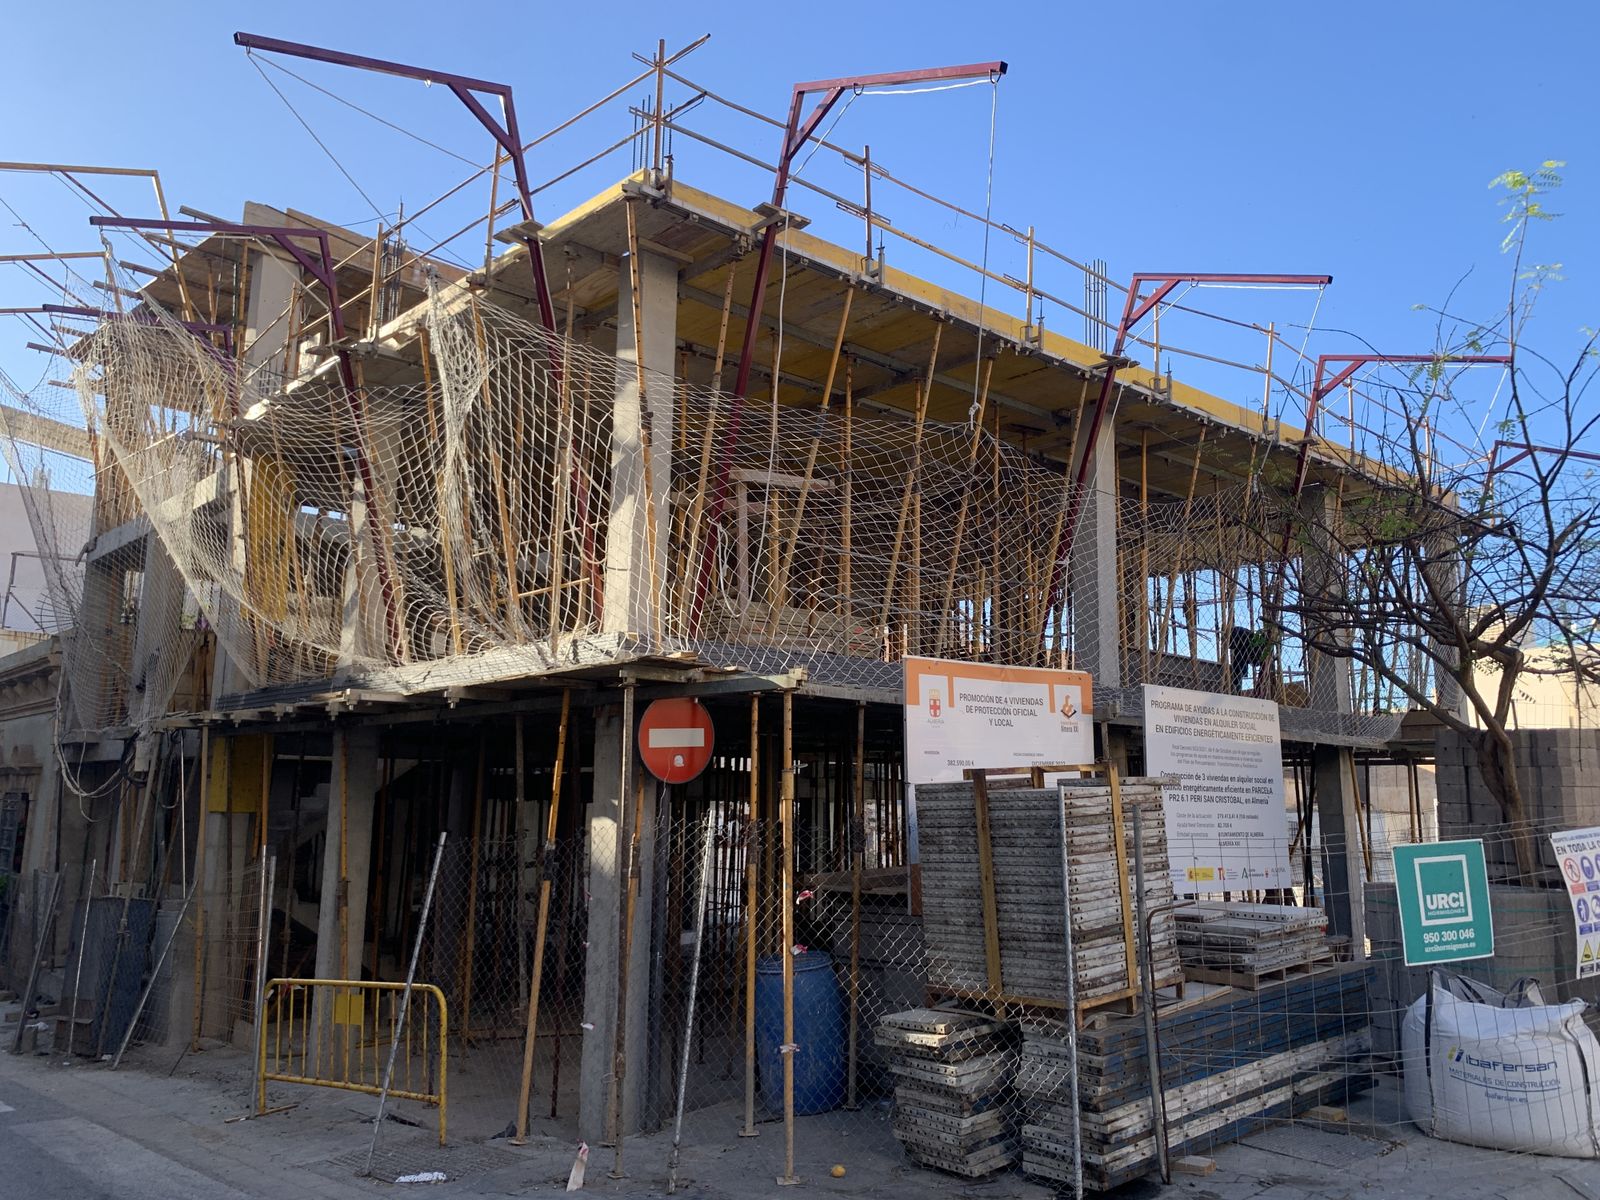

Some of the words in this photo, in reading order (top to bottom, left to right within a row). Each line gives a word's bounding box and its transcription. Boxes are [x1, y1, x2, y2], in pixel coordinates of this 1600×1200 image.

[960, 693, 994, 704] PROMOCIÓN
[996, 696, 1003, 704] DE
[1009, 697, 1043, 706] VIVIENDAS
[966, 705, 973, 713] DE
[975, 705, 1011, 716] PROTECCIÓN
[1013, 708, 1038, 716] OFICIAL
[1151, 700, 1184, 711] PROGRAMA
[1184, 704, 1193, 712] DE
[1194, 705, 1215, 715] AYUDAS
[1229, 709, 1267, 721] CONSTRUCCIÓN
[995, 718, 1014, 727] LOCAL
[1174, 714, 1203, 725] VIVIENDAS
[1213, 719, 1238, 729] ALQUILER
[1239, 721, 1256, 730] SOCIAL
[1156, 724, 1164, 733] EN
[1165, 725, 1192, 736] EDIFICIOS
[1193, 728, 1244, 741] ENERGÉTICAMENTE
[1245, 733, 1273, 743] EFICIENTES
[1195, 772, 1201, 780] de
[1206, 774, 1228, 782] viviendas
[1236, 775, 1253, 784] alquiler
[1254, 776, 1267, 784] social
[1224, 785, 1245, 793] eficiente
[1252, 786, 1272, 794] PARCELA
[1190, 794, 1202, 802] PERI
[1204, 795, 1215, 803] SAN
[1556, 846, 1566, 855] EN
[1567, 842, 1586, 853] TODA
[1587, 841, 1596, 850] LA
[1426, 892, 1464, 910] URCI
[1424, 932, 1440, 944] 950
[1442, 930, 1457, 942] 300
[1459, 928, 1474, 940] 046
[1466, 1054, 1558, 1072] ibafersan
[1448, 1067, 1492, 1084] MATERIALES
